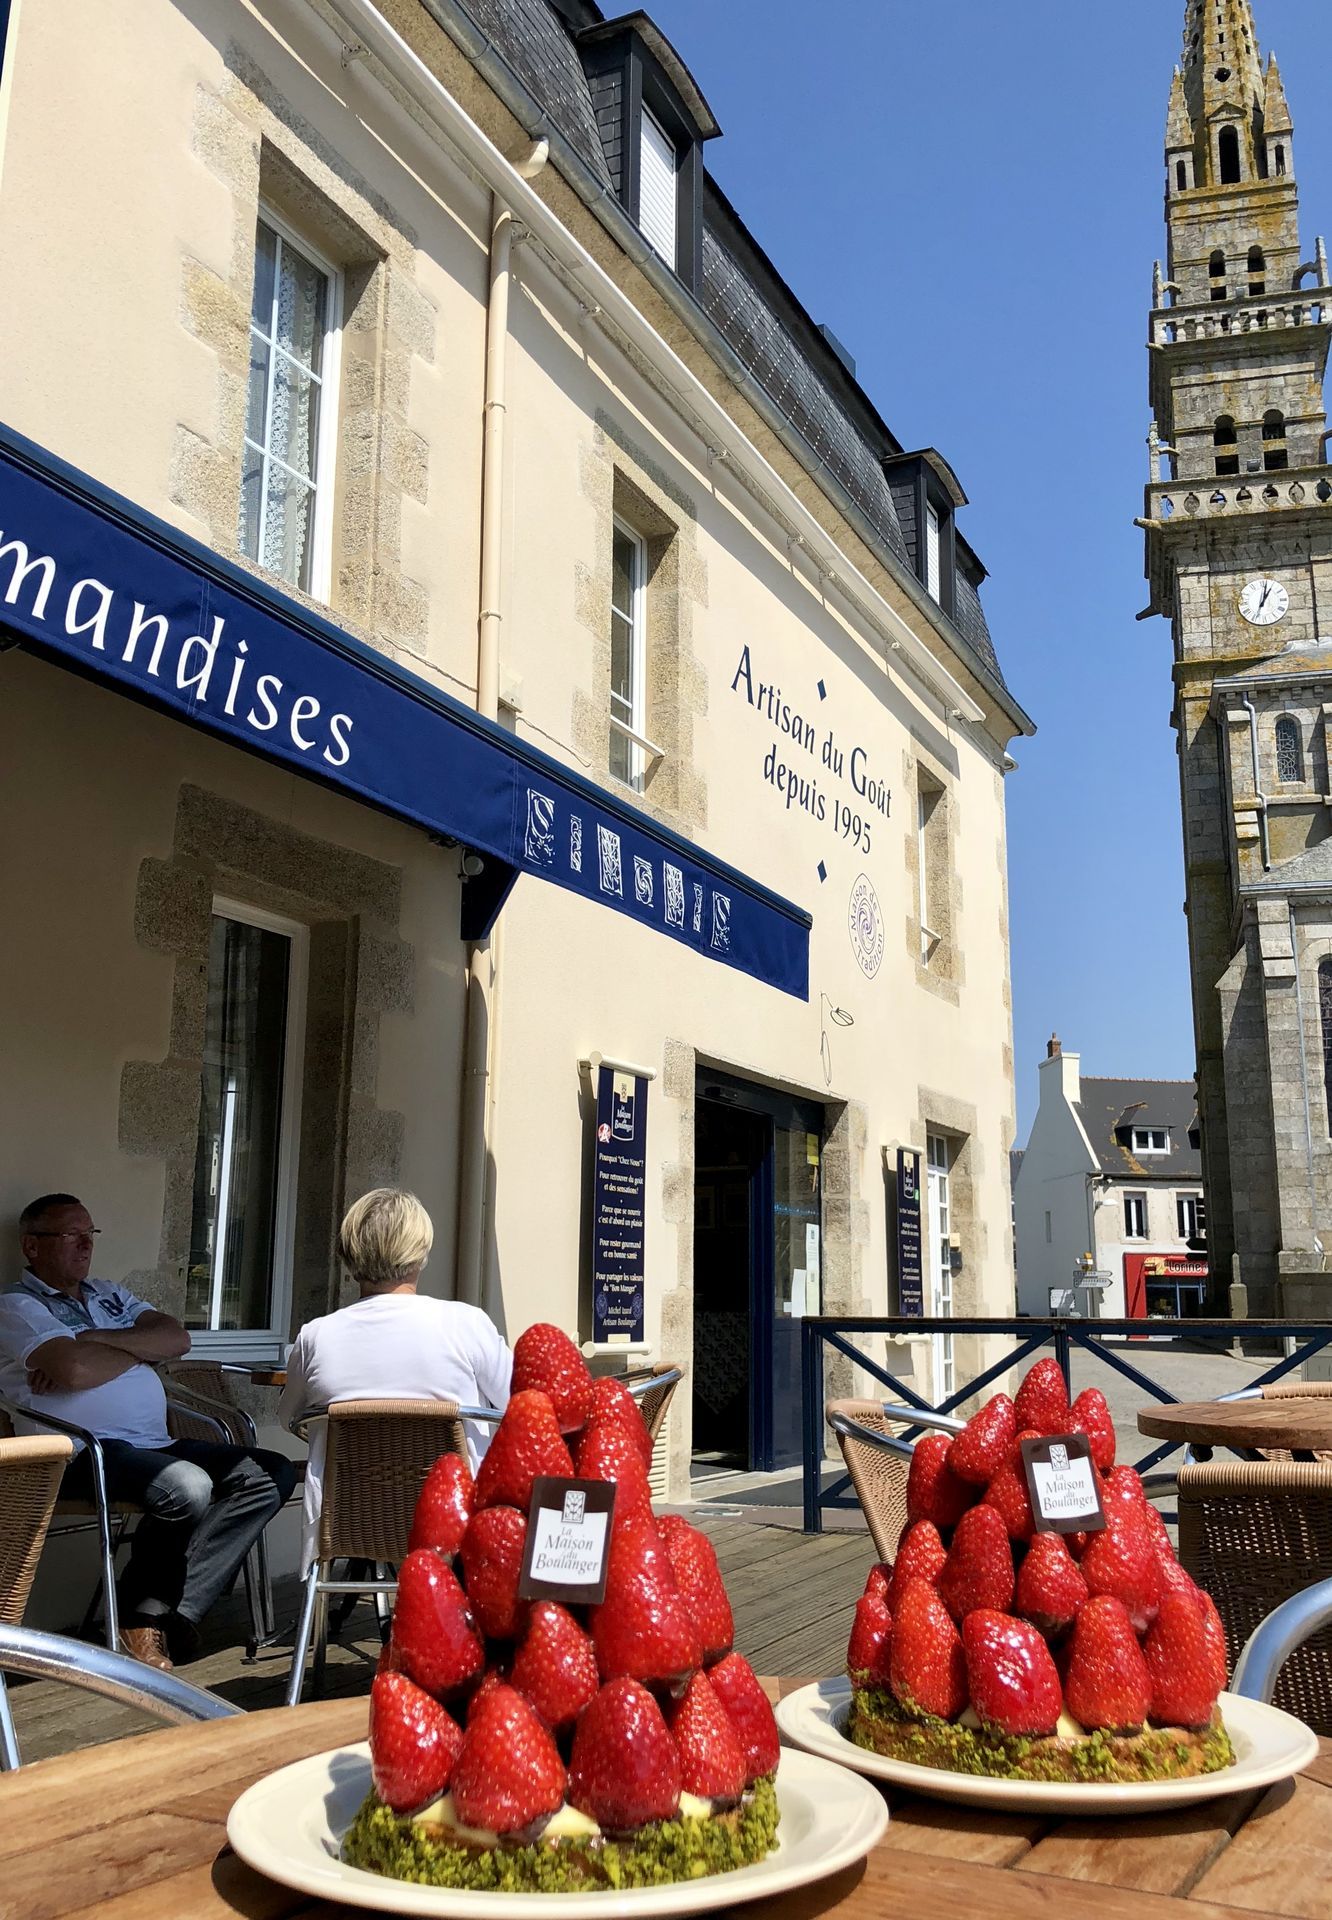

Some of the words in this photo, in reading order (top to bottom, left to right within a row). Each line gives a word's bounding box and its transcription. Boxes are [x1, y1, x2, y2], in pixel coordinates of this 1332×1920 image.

[0, 530, 354, 766] mandises
[731, 644, 815, 755] Artisan
[822, 731, 844, 779] du
[850, 747, 892, 818] Goût
[763, 743, 825, 834] depuis
[834, 800, 871, 854] 1995
[850, 884, 867, 931] Maison
[869, 892, 878, 913] de
[857, 933, 883, 971] Tradition
[616, 1109, 632, 1119] Maison
[614, 1120, 633, 1132] Boulanger
[598, 1153, 618, 1164] Pourquoi
[599, 1171, 609, 1179] Pour
[610, 1174, 628, 1182] retrouver
[614, 1206, 622, 1215] que
[608, 1216, 624, 1226] d'abord
[630, 1219, 643, 1228] plaisir
[599, 1238, 609, 1246] Pour
[622, 1240, 642, 1250] gourmand
[614, 1250, 626, 1258] bonne
[596, 1272, 606, 1280] Pour
[606, 1273, 623, 1282] partager
[602, 1284, 609, 1292] du
[608, 1306, 622, 1314] Michel
[602, 1318, 617, 1326] Artisan
[618, 1318, 637, 1328] Boulanger
[1055, 1473, 1064, 1481] La
[1045, 1480, 1085, 1494] Maison
[1066, 1490, 1075, 1498] du
[1043, 1495, 1094, 1511] Boulanger
[561, 1527, 573, 1536] La
[545, 1535, 594, 1551] Maison
[565, 1550, 578, 1560] du
[535, 1553, 599, 1575] Boulanger
